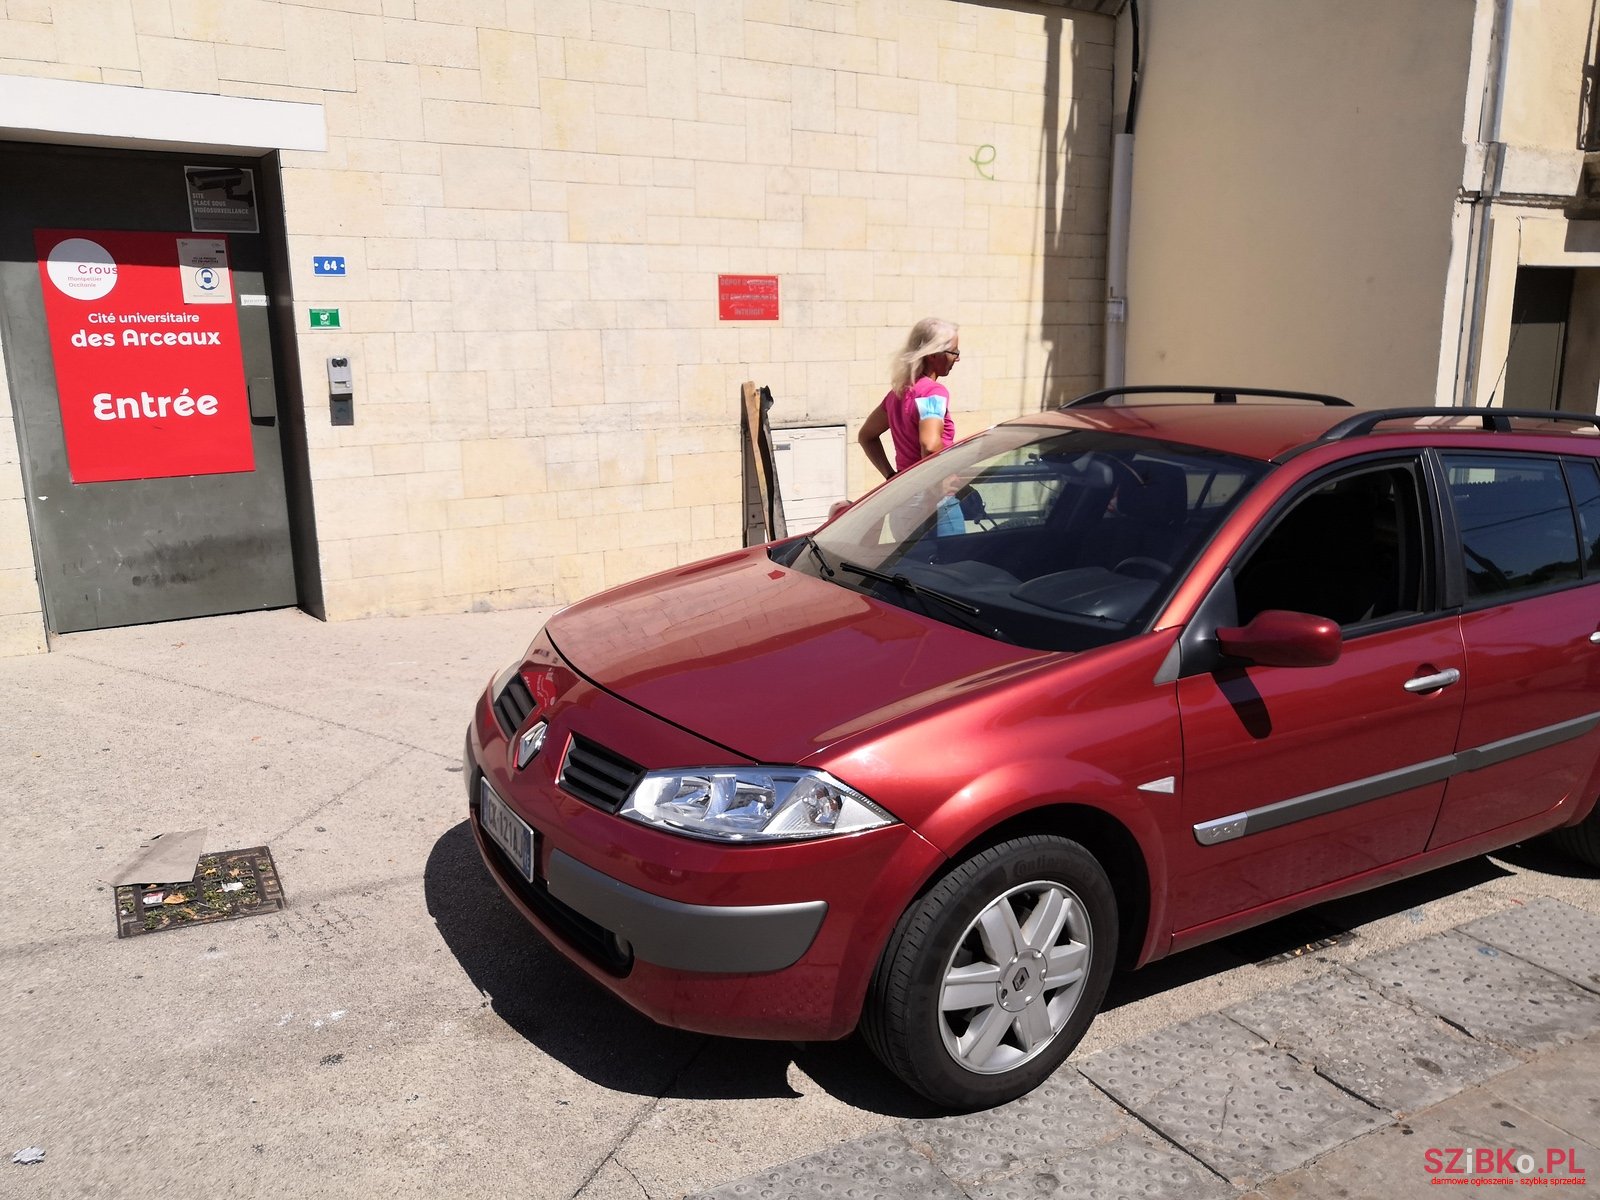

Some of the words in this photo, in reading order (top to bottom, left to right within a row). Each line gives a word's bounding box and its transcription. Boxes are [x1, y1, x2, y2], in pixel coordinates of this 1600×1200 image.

[78, 264, 118, 275] Crous
[323, 260, 337, 271] 64
[88, 312, 116, 324] Cité
[119, 312, 200, 323] universitaire
[71, 329, 116, 348] des
[122, 329, 221, 346] Arceaux
[93, 388, 219, 421] Entrée
[1012, 855, 1082, 878] Contin
